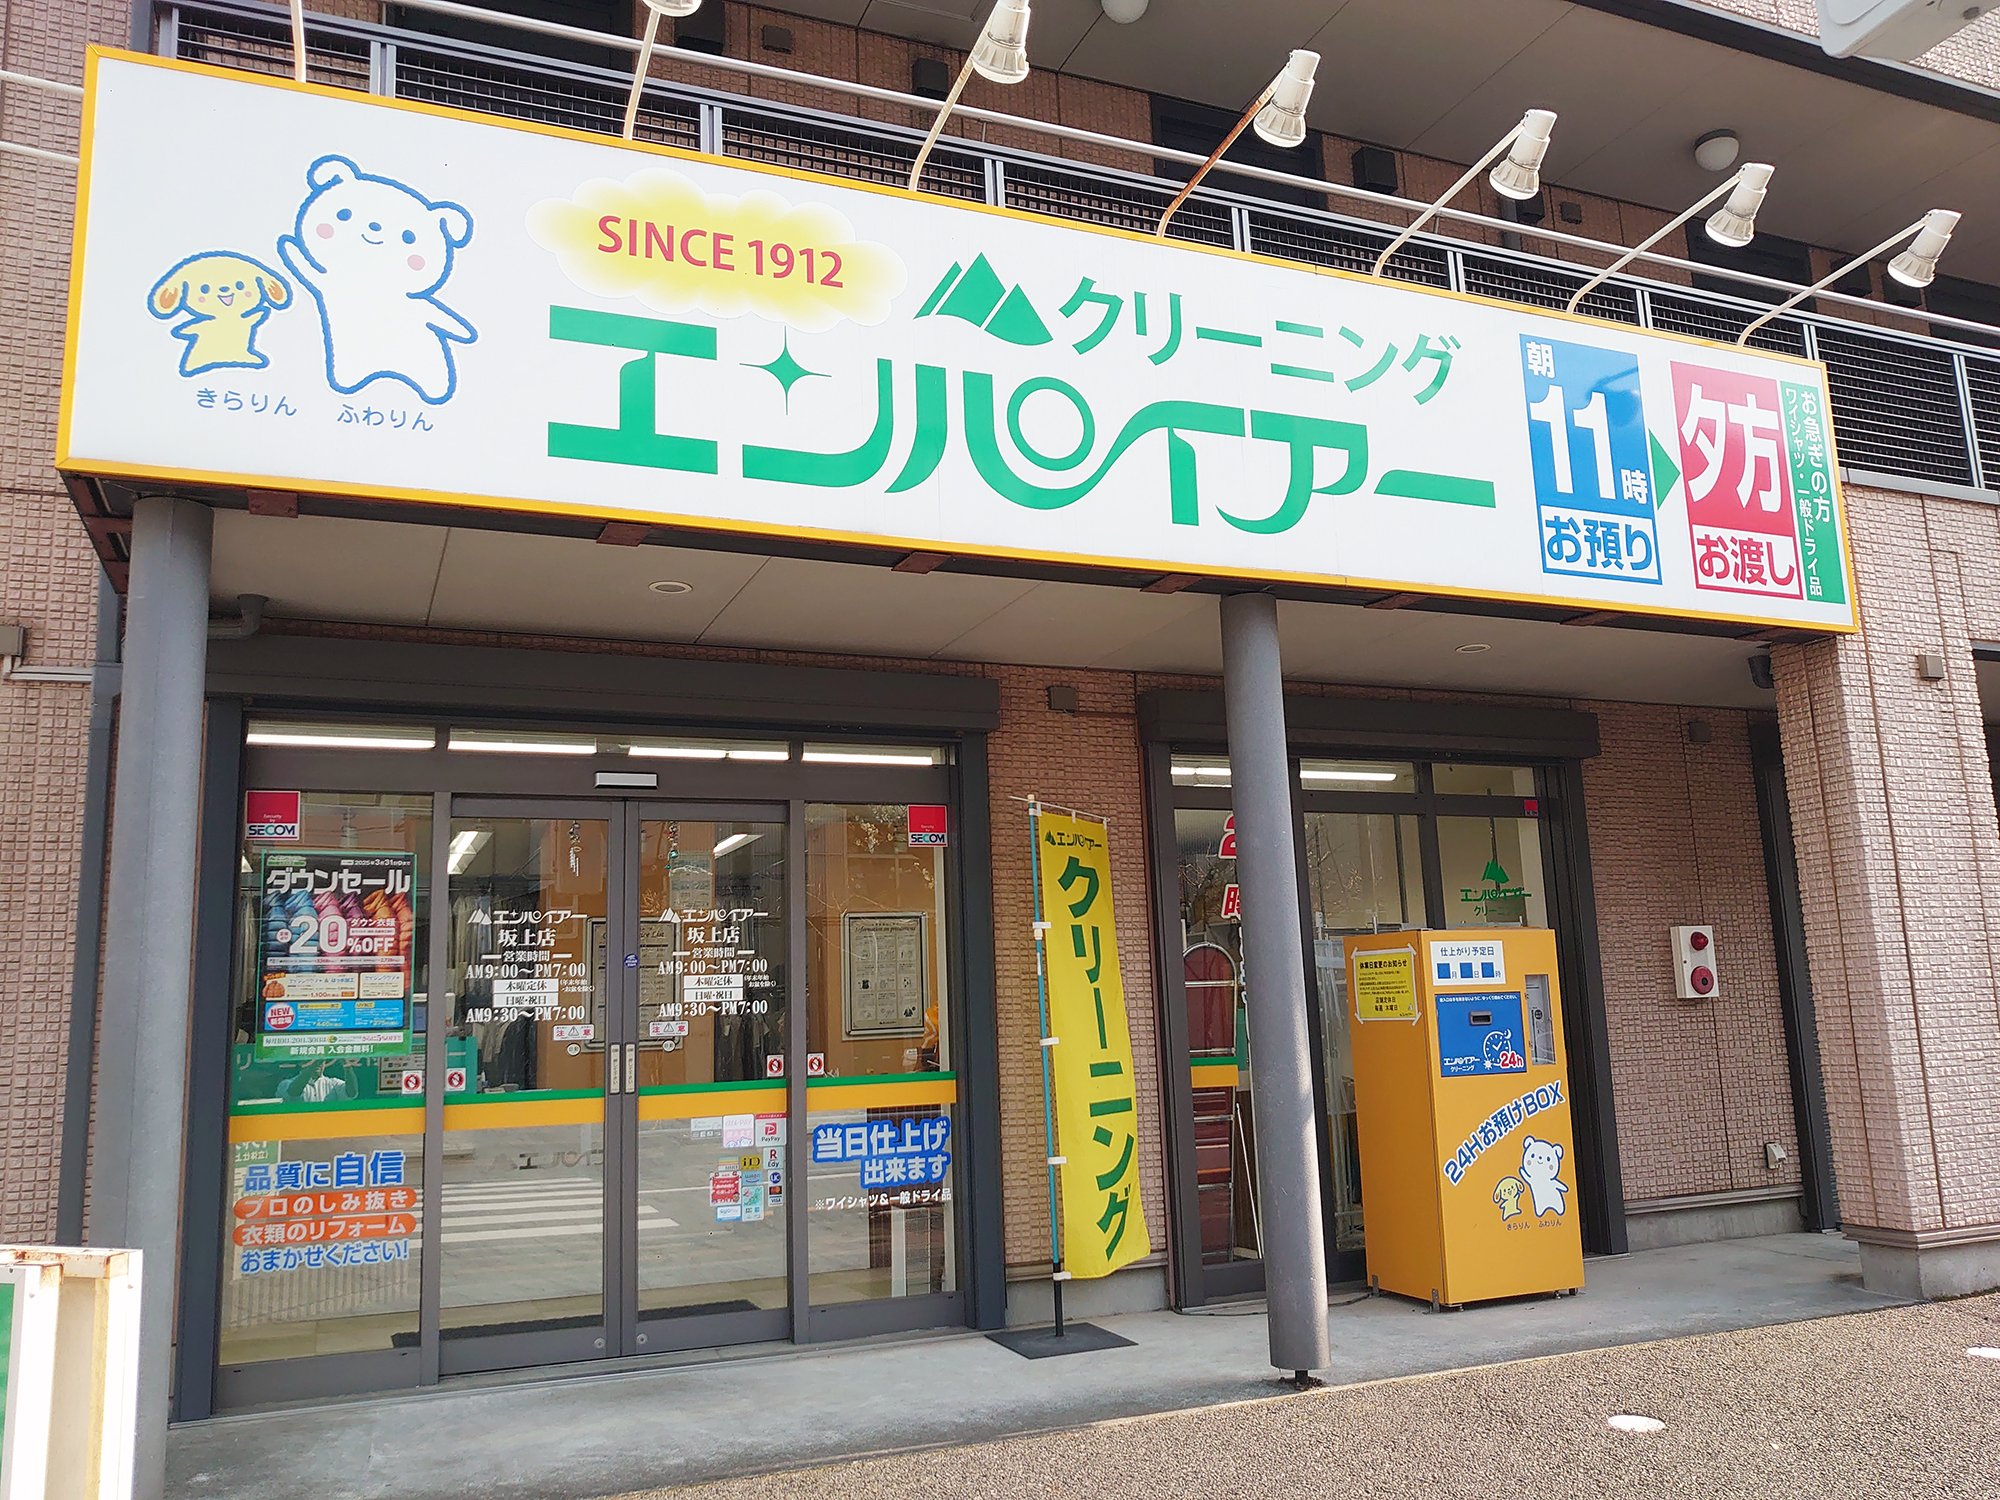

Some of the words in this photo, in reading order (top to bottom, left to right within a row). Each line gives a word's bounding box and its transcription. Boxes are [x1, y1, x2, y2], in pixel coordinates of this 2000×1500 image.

[598, 215, 735, 272] SINCE
[748, 240, 843, 288] 1912
[1059, 277, 1463, 406] クリーニング
[1526, 341, 1555, 379] 朝
[197, 387, 297, 416] きらりん
[337, 403, 434, 432] ふわりん
[547, 304, 1497, 534] エンパイアー
[1680, 383, 1781, 513] 夕方
[1801, 390, 1830, 523] お急ぎの方
[1785, 388, 1823, 597] ワイシャツ・一般ドライ品
[1545, 515, 1653, 571] お預り
[1696, 533, 1795, 586] お渡し
[248, 824, 296, 836] SECOM
[911, 832, 945, 843] SECOM
[266, 867, 411, 895] ダウンセール
[1460, 888, 1531, 902] エンパイアー
[351, 918, 396, 927] ダウン衣類
[493, 910, 587, 925] エンパイアー
[682, 908, 768, 922] エンパイアー
[498, 928, 556, 947] 坂上店
[687, 926, 740, 944] 坂上店
[503, 950, 550, 962] 営業時間
[692, 947, 735, 958] 営業時間
[1440, 946, 1495, 956] 仕上がり予定日
[695, 976, 733, 987] 木曜定休
[1474, 970, 1479, 978] 日
[1495, 970, 1501, 978] 時
[505, 981, 547, 991] 木曜定休
[506, 995, 547, 1005] 日曜・祝日
[695, 991, 733, 1000] 日曜・祝日
[270, 1007, 291, 1016] NEW
[290, 1046, 325, 1055] 新規会員
[1057, 855, 1134, 1261] クリーニング
[1443, 1056, 1480, 1065] エンパイアー
[1450, 1064, 1475, 1072] クリーニング
[1500, 1052, 1524, 1068] 24h
[815, 1120, 948, 1160] 当日仕上げ
[1444, 1080, 1564, 1185] 24Hお預けBOX
[770, 1149, 777, 1159] R
[245, 1151, 405, 1192] 品質に自信
[863, 1154, 948, 1185] 出来ます
[244, 1190, 409, 1219] プロのしみ抜き
[241, 1216, 407, 1245] 衣類のリフォーム
[1507, 1222, 1530, 1231] きらりん
[1538, 1220, 1562, 1228] ふわりん
